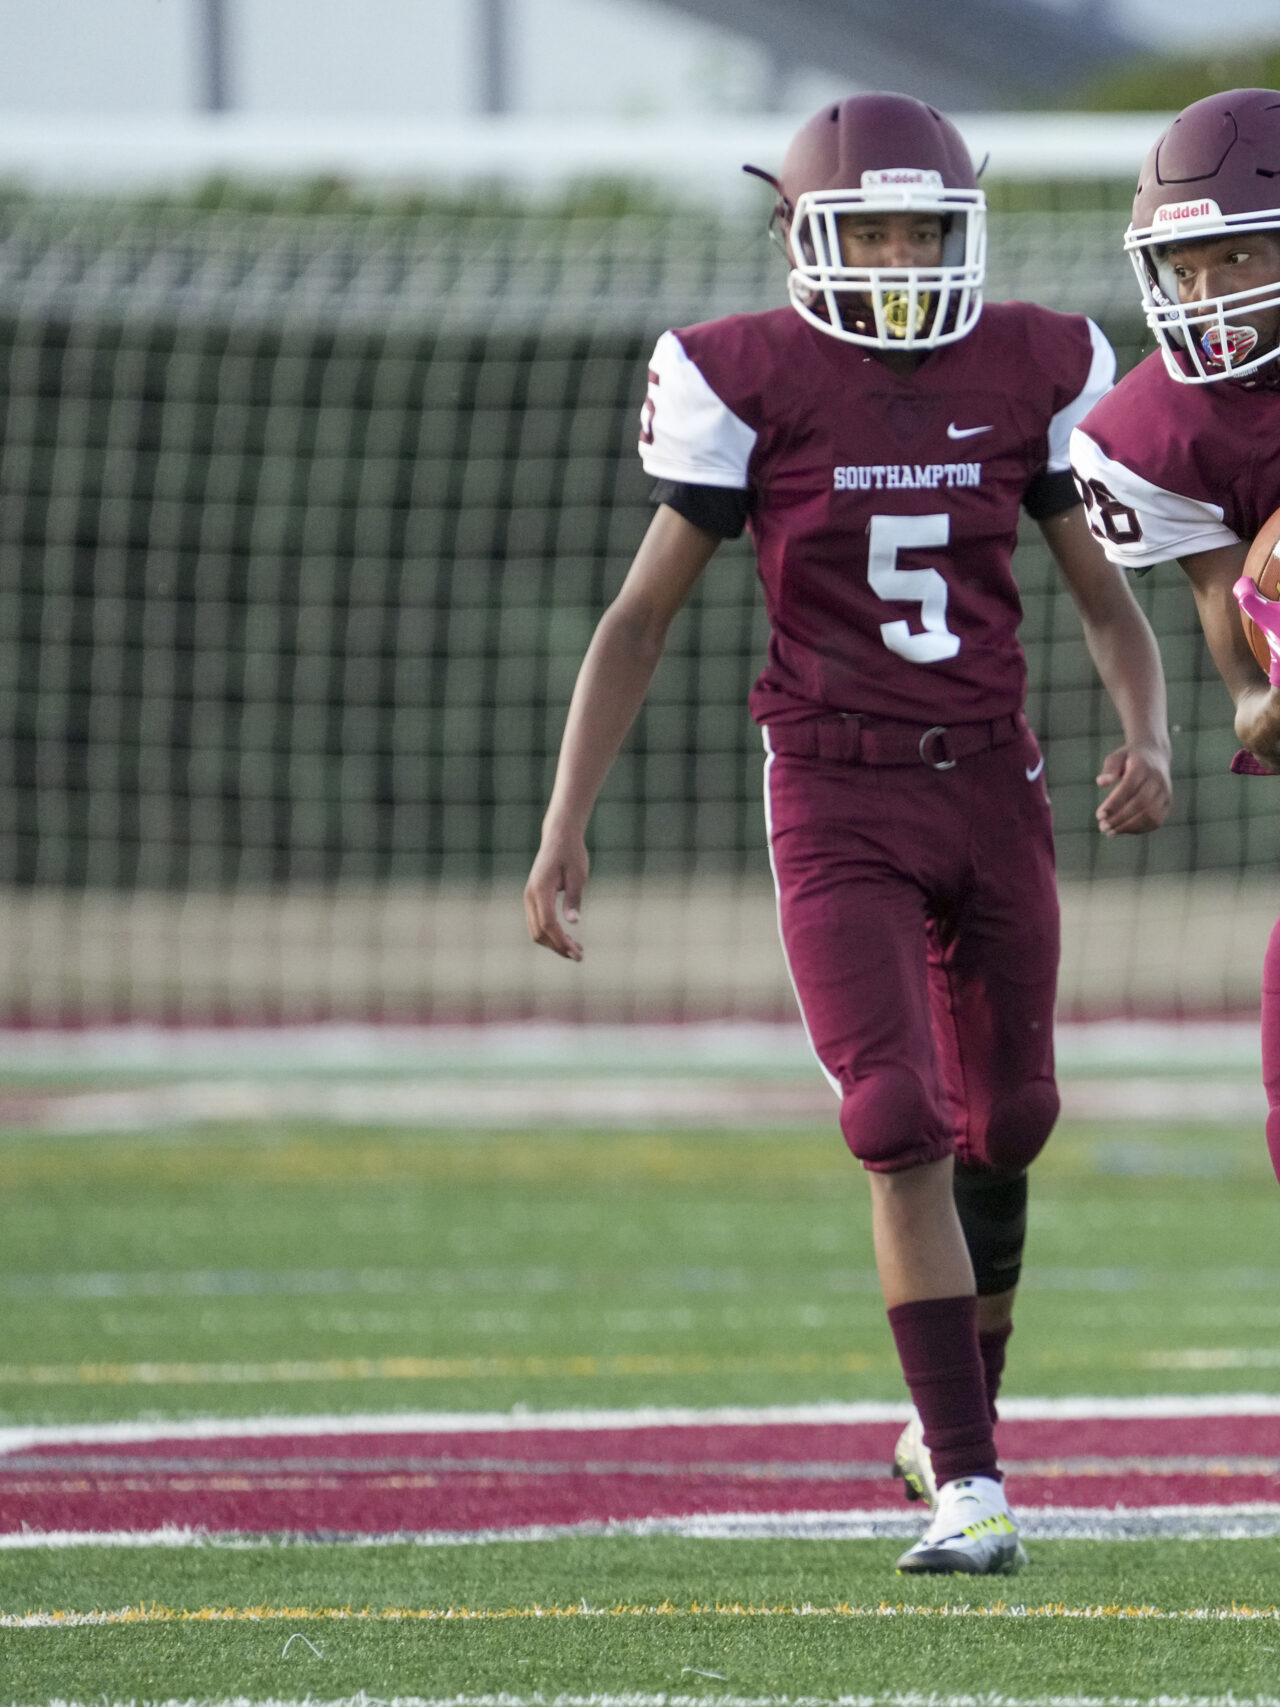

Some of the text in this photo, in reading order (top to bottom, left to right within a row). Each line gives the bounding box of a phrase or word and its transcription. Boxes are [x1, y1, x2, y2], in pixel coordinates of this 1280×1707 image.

[1159, 202, 1210, 222] Riddell
[833, 462, 982, 491] SOUTHAMPTON
[866, 512, 961, 664] 5
